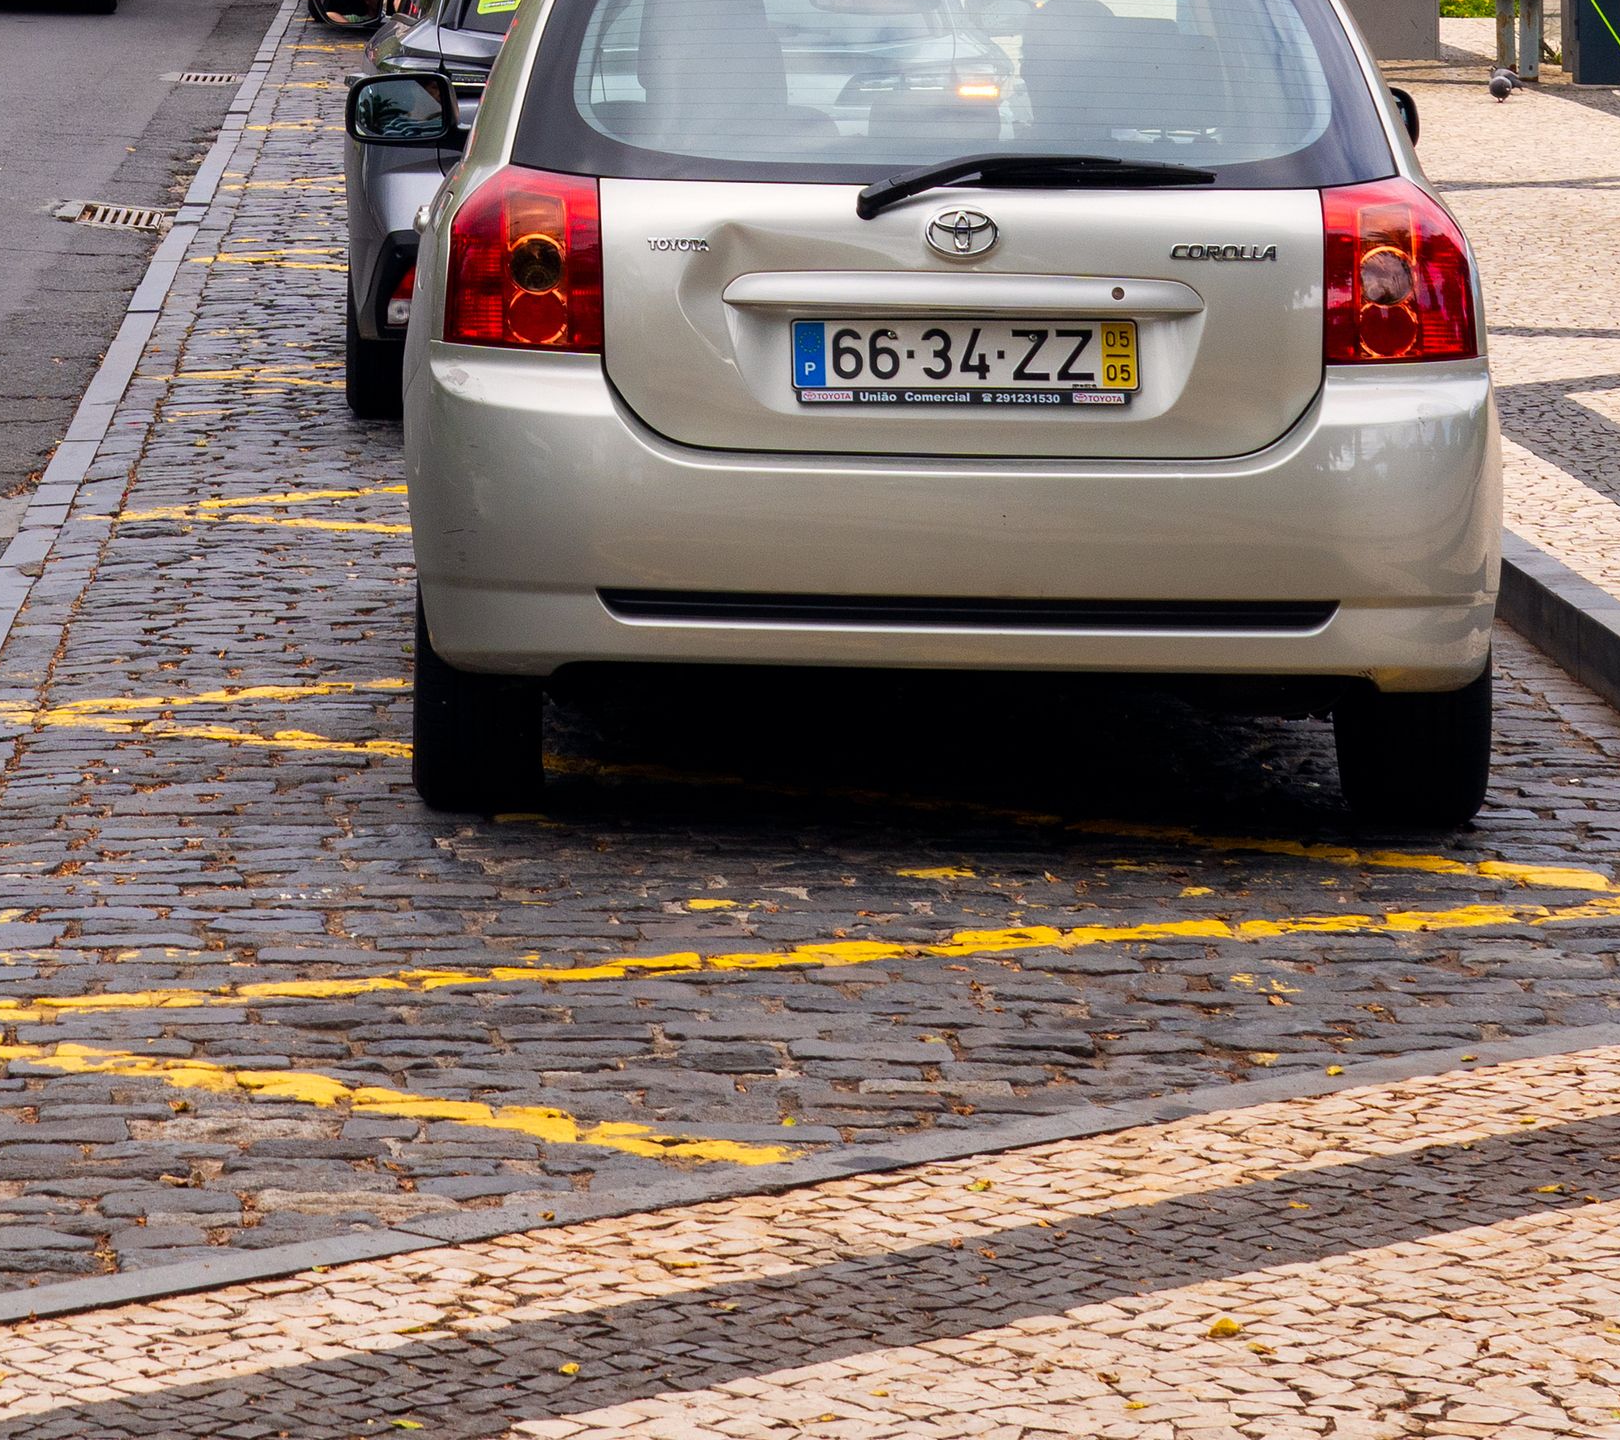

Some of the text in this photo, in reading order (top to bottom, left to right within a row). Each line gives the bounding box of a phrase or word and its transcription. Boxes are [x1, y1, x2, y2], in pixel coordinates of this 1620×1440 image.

[647, 236, 710, 252] TOYOTA
[1169, 243, 1278, 262] COROLLA
[1105, 330, 1131, 348] 05
[804, 362, 816, 376] P
[1105, 364, 1132, 382] 05
[816, 391, 1122, 404] TOYOTA União Comercial 291231530 TOYOTA
